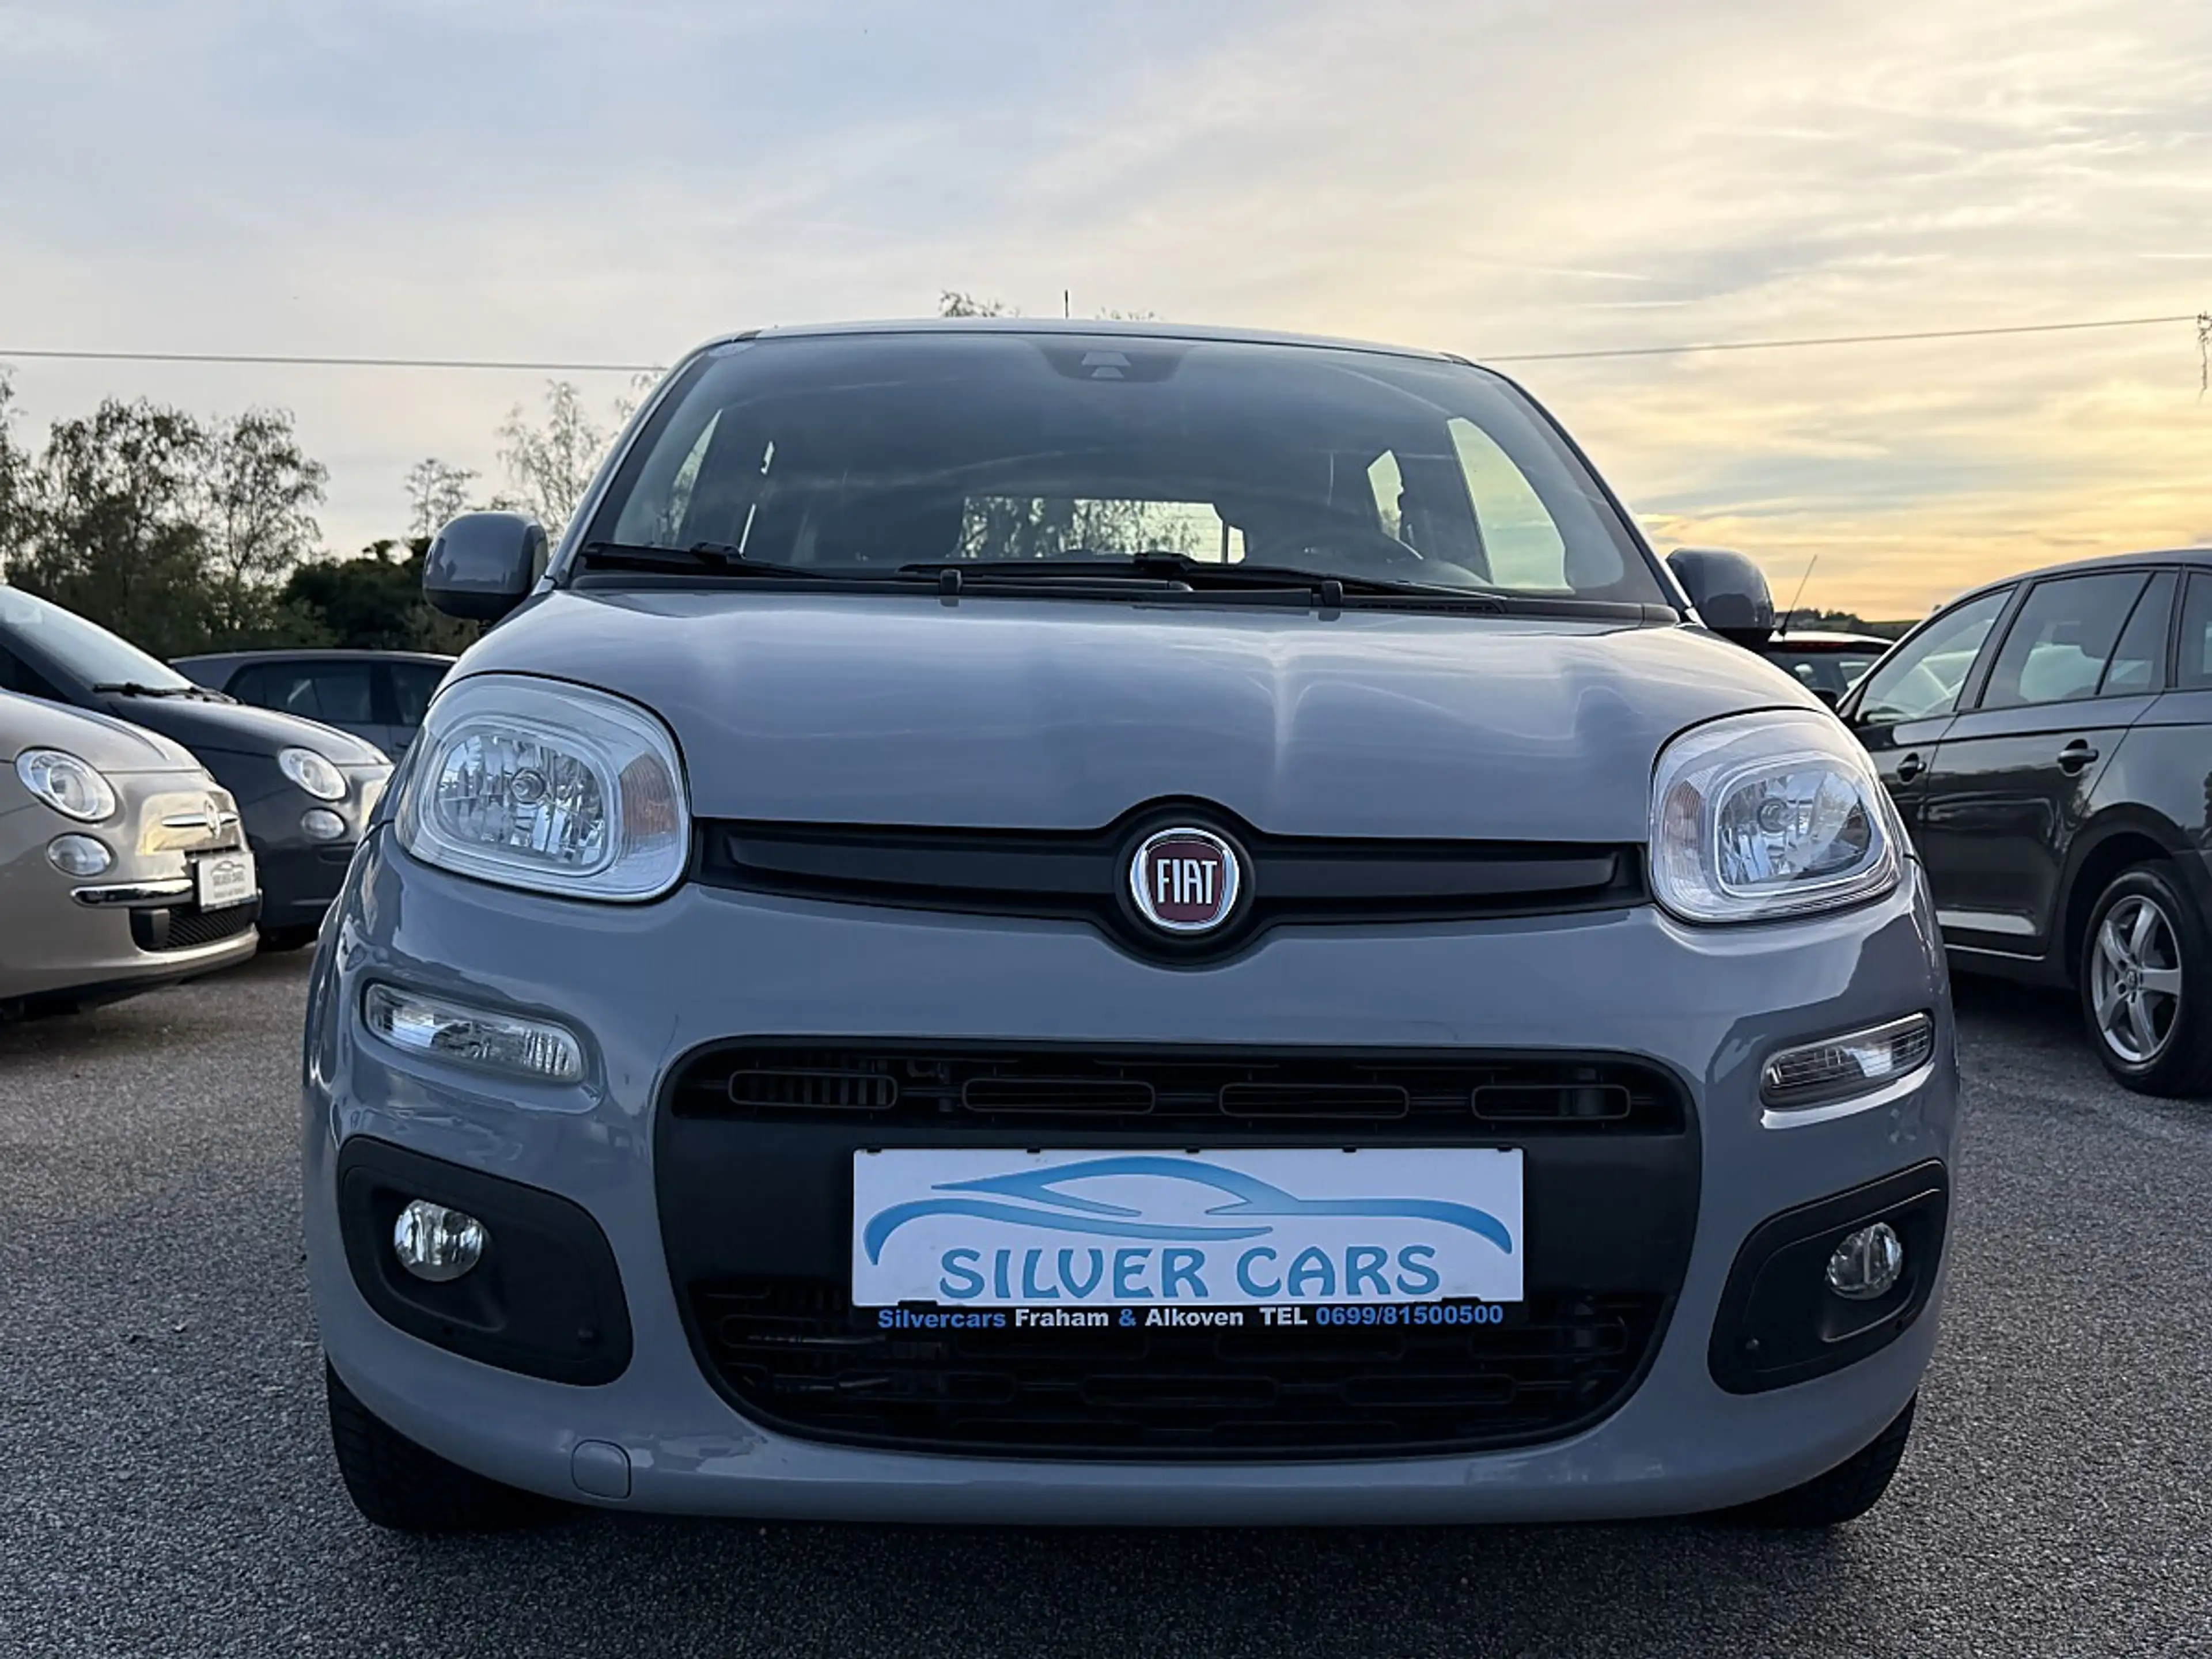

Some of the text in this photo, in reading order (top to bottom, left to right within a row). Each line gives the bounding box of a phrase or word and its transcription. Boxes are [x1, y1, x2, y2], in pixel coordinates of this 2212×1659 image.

[1157, 858, 1218, 904] FIAT
[939, 1244, 1440, 1299] SILVER CARS
[877, 1304, 1504, 1328] Silvercars Fraham & Alkoven TEL 0699/81500500
